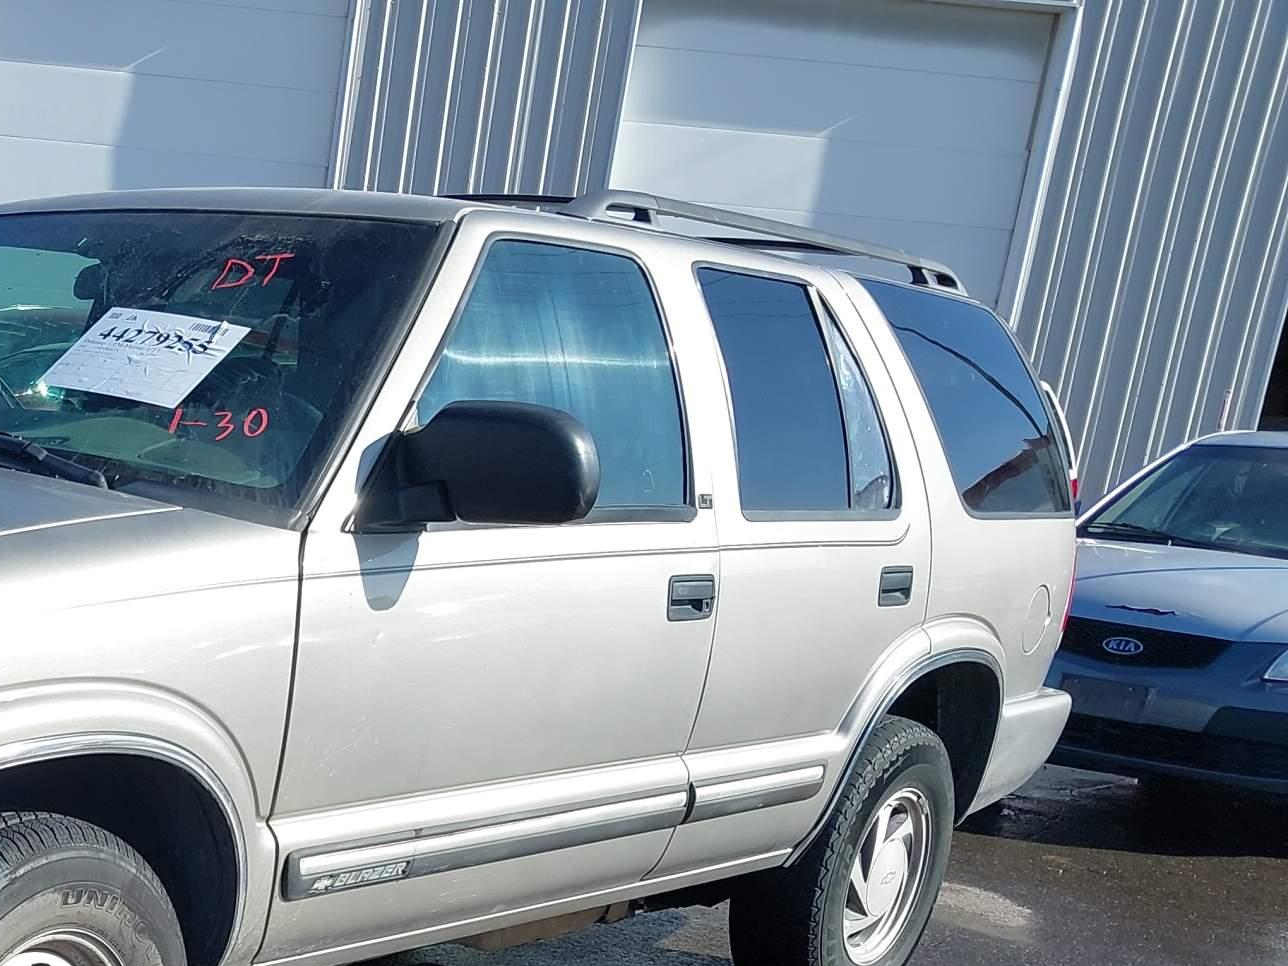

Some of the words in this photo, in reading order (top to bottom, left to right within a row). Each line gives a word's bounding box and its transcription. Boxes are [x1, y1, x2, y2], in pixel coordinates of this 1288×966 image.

[211, 252, 296, 291] DT
[98, 325, 214, 355] 44279255
[167, 407, 271, 442] 1-30
[1108, 640, 1135, 652] KIA
[332, 861, 409, 888] BLAZER
